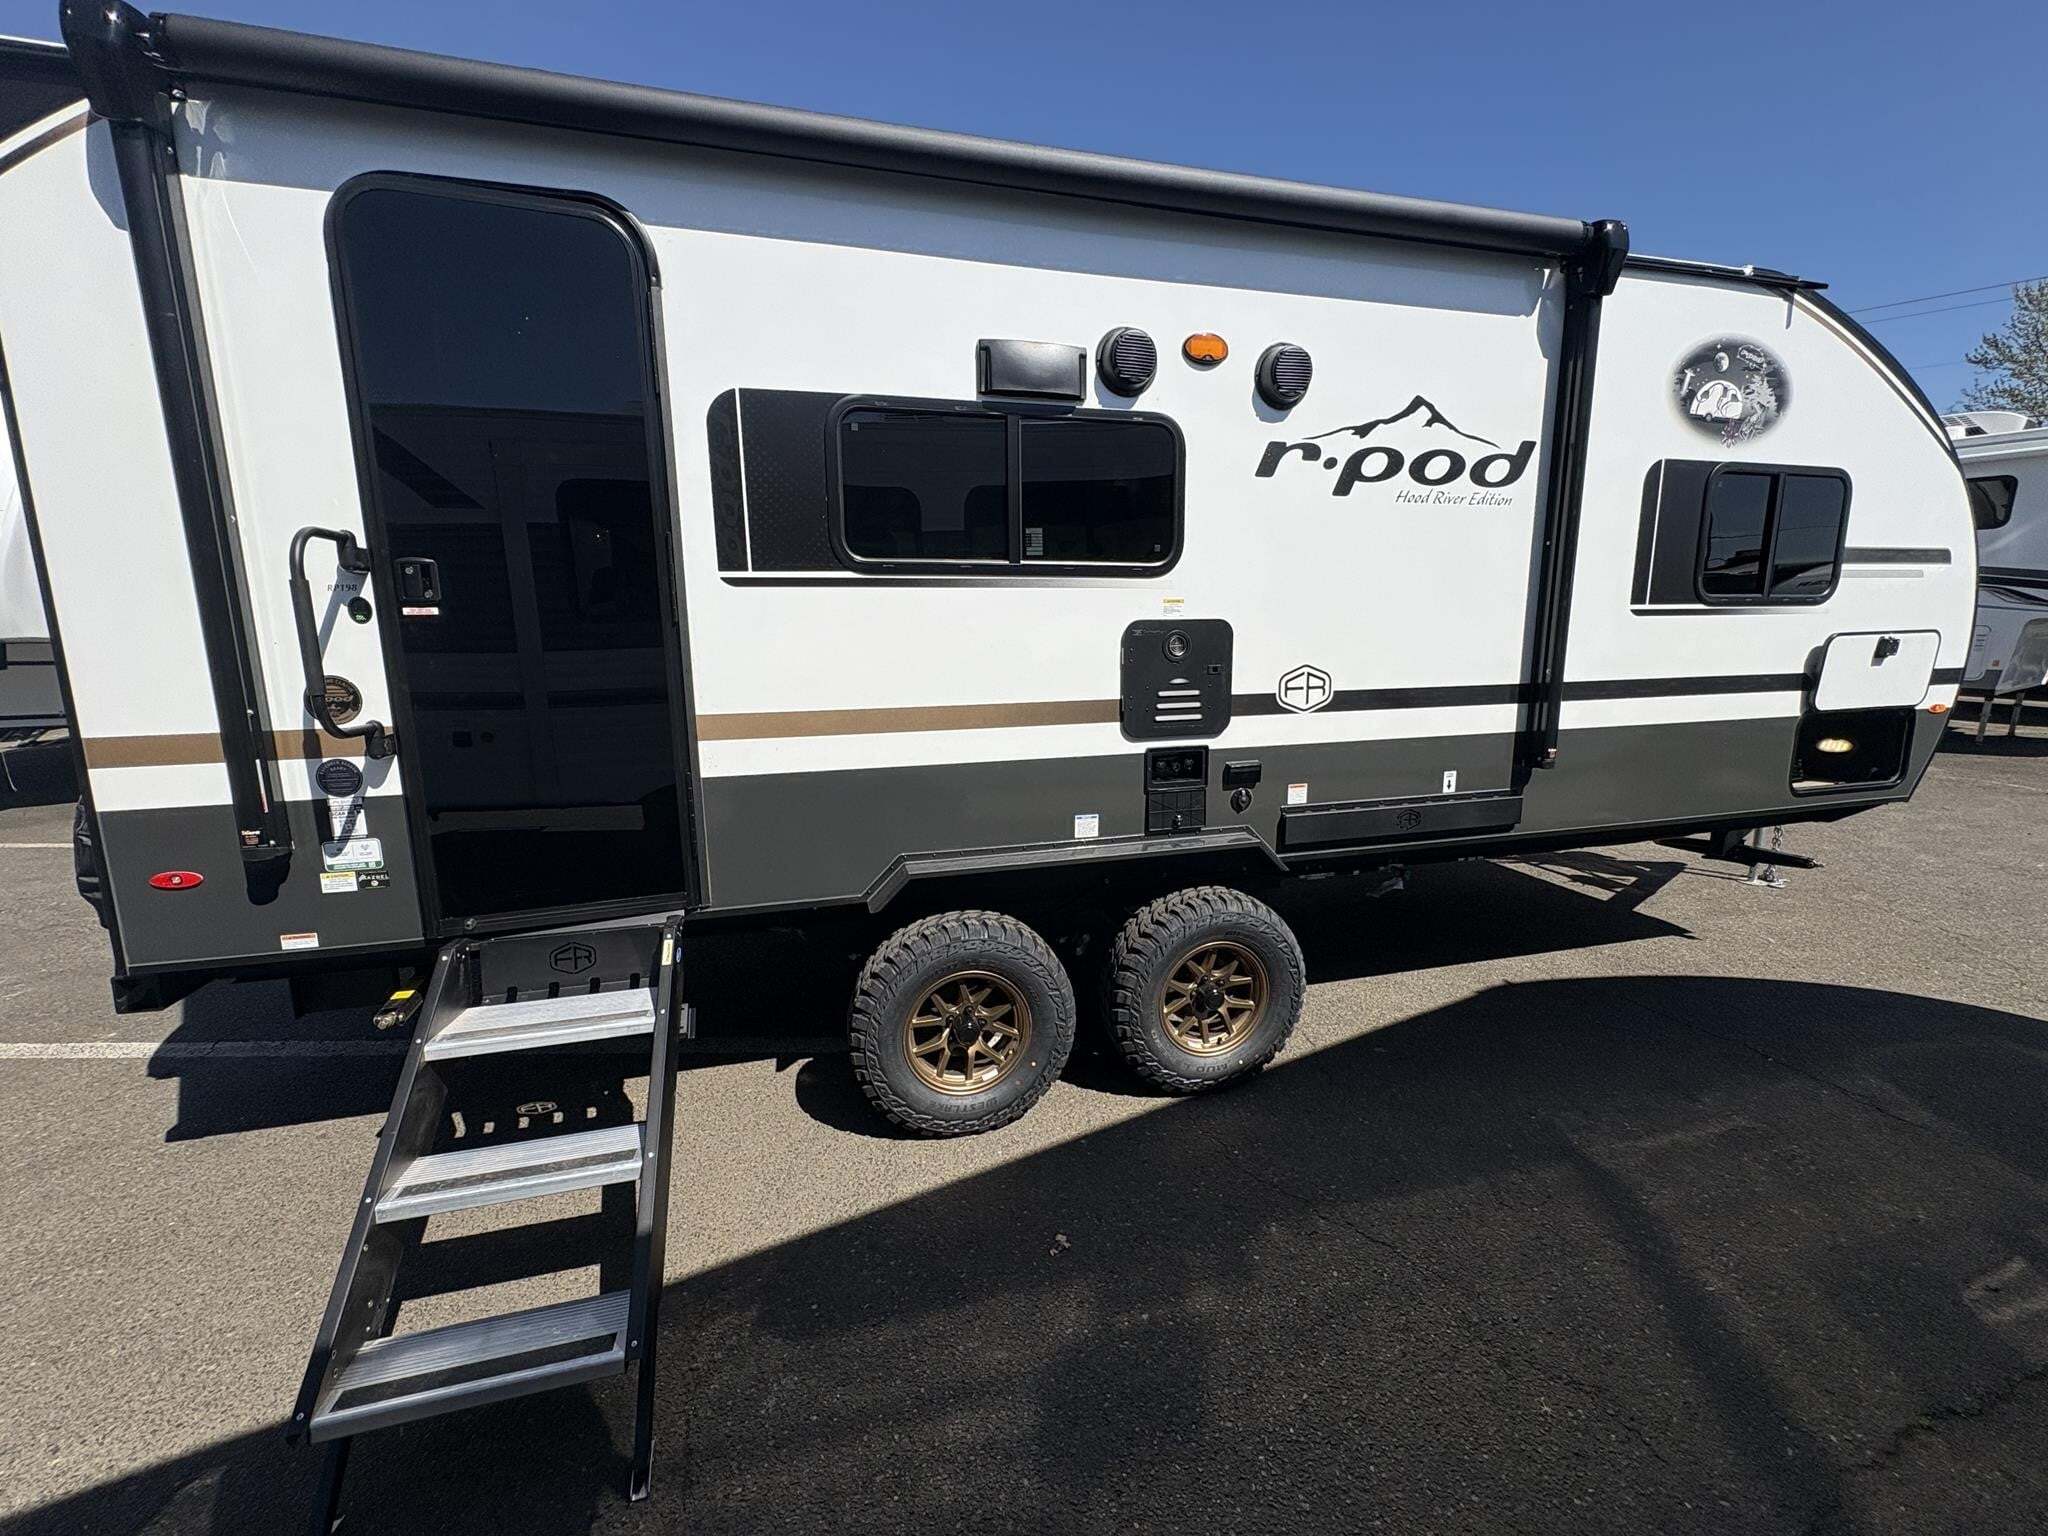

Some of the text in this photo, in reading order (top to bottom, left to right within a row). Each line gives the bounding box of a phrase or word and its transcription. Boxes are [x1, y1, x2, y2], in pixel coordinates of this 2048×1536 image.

[1395, 489, 1513, 507] Hood River Edition
[1284, 671, 1327, 706] FR
